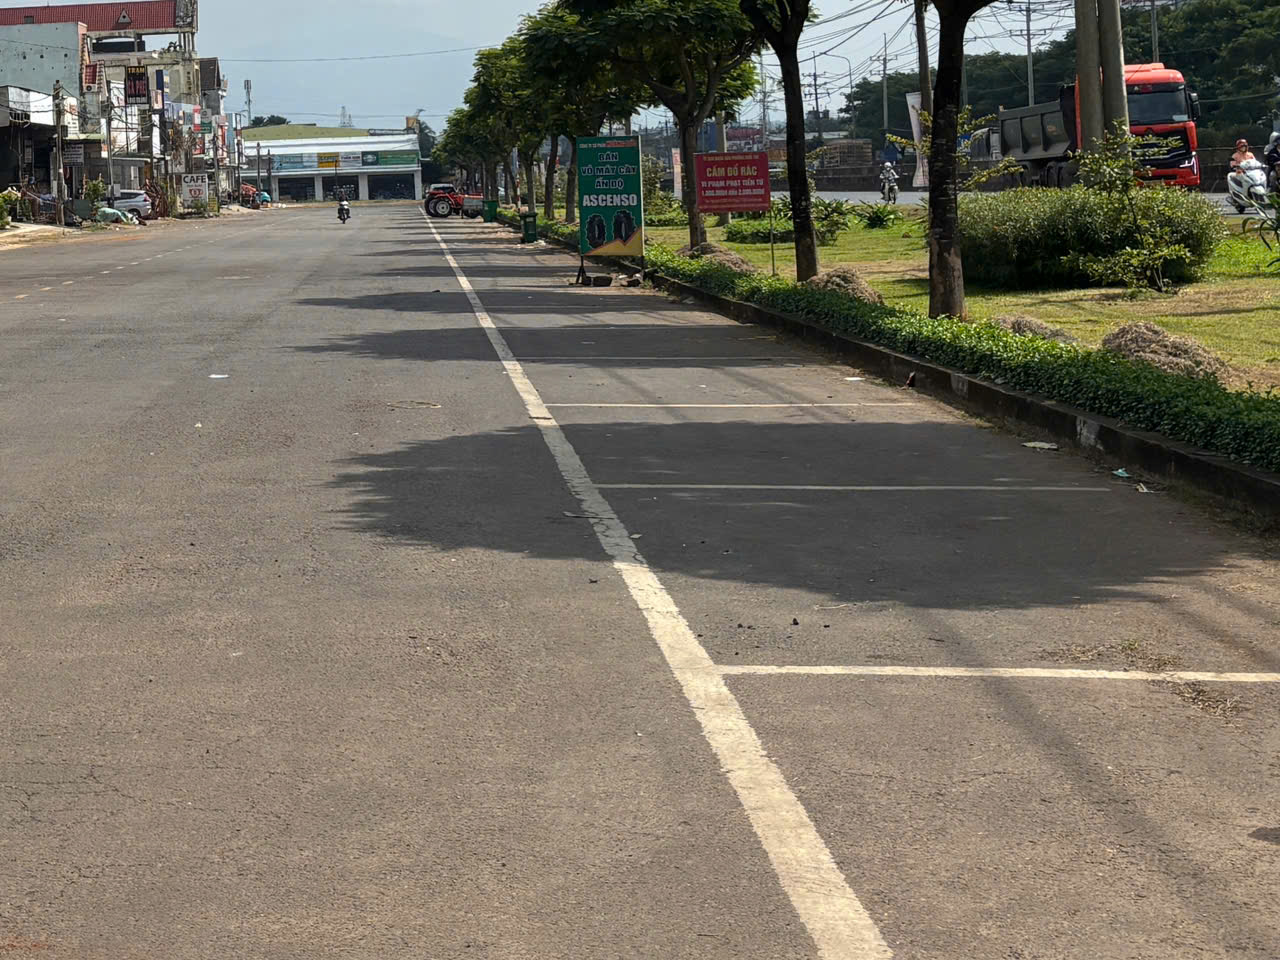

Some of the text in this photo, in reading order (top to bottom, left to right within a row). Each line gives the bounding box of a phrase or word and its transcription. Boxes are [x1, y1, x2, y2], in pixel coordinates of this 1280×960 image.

[598, 151, 619, 162] BÁN
[183, 175, 207, 184] CAFE
[582, 194, 638, 207] ASCENSO
